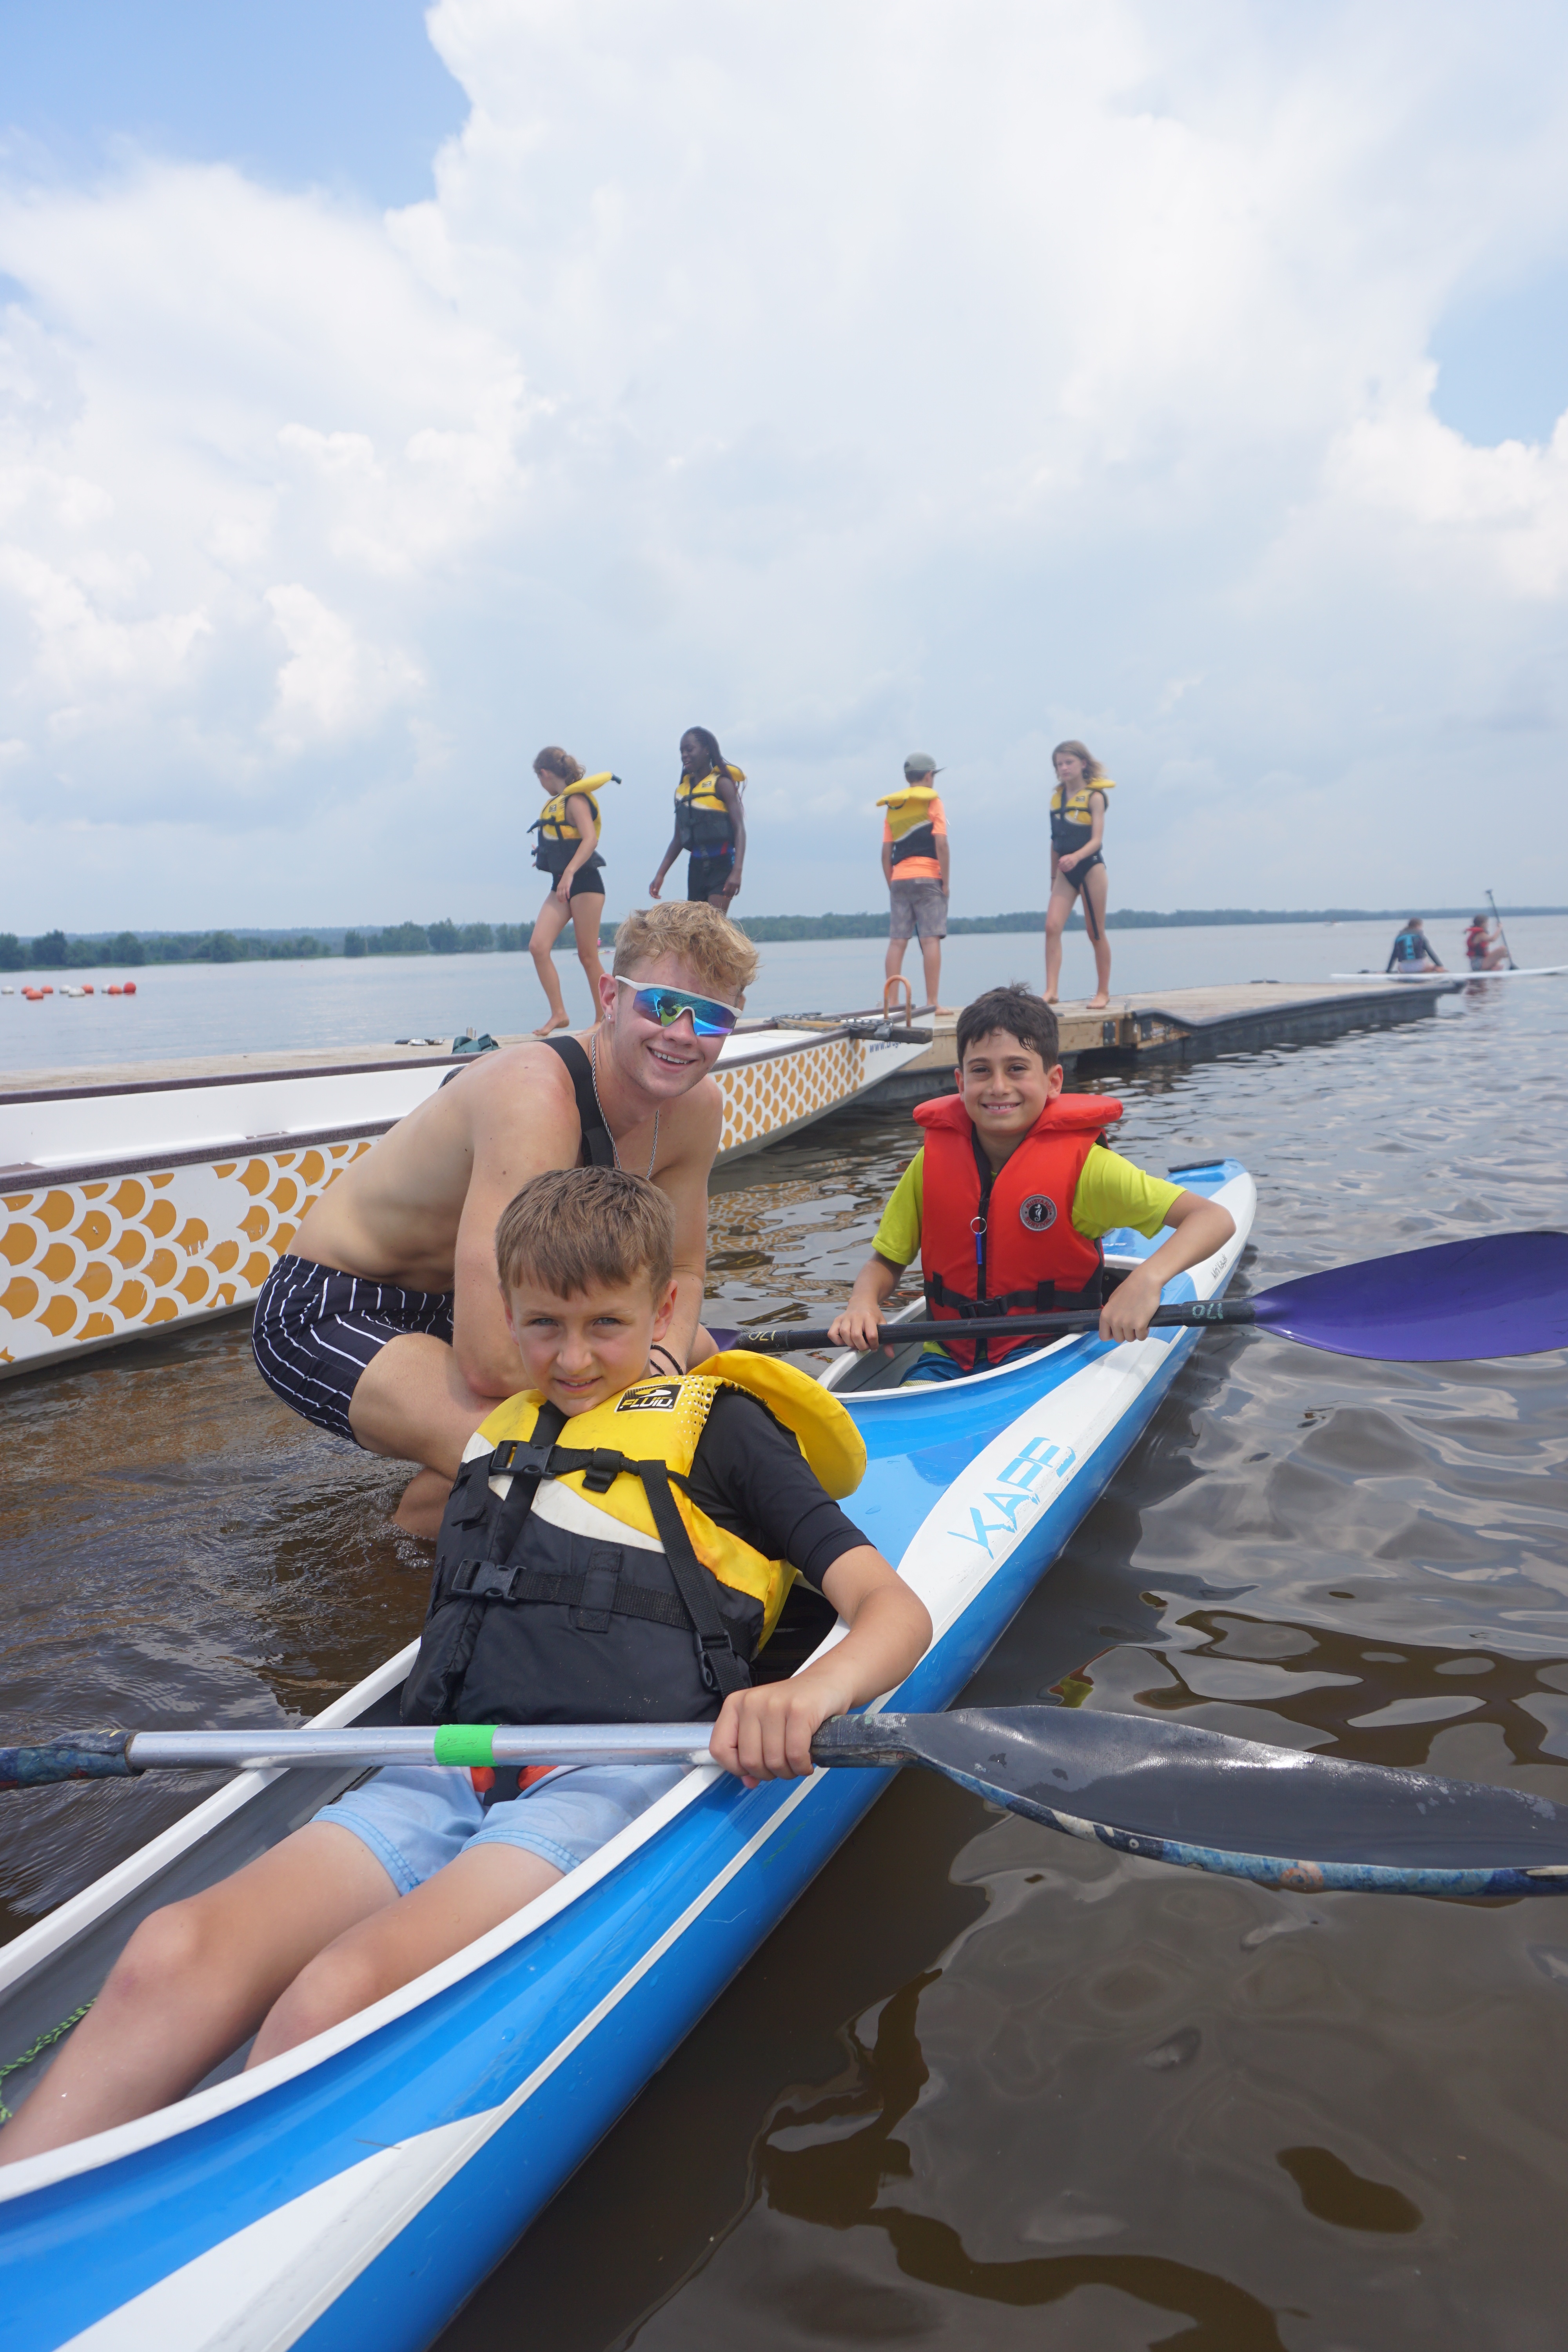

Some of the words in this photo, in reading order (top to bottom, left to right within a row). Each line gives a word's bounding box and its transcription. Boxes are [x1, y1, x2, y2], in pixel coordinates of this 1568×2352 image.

[1025, 1198, 1052, 1212] MUSTANG
[1025, 1216, 1052, 1228] SURVIVAL
[619, 1397, 673, 1409] FLUID
[947, 1437, 1076, 1559] KAPE
